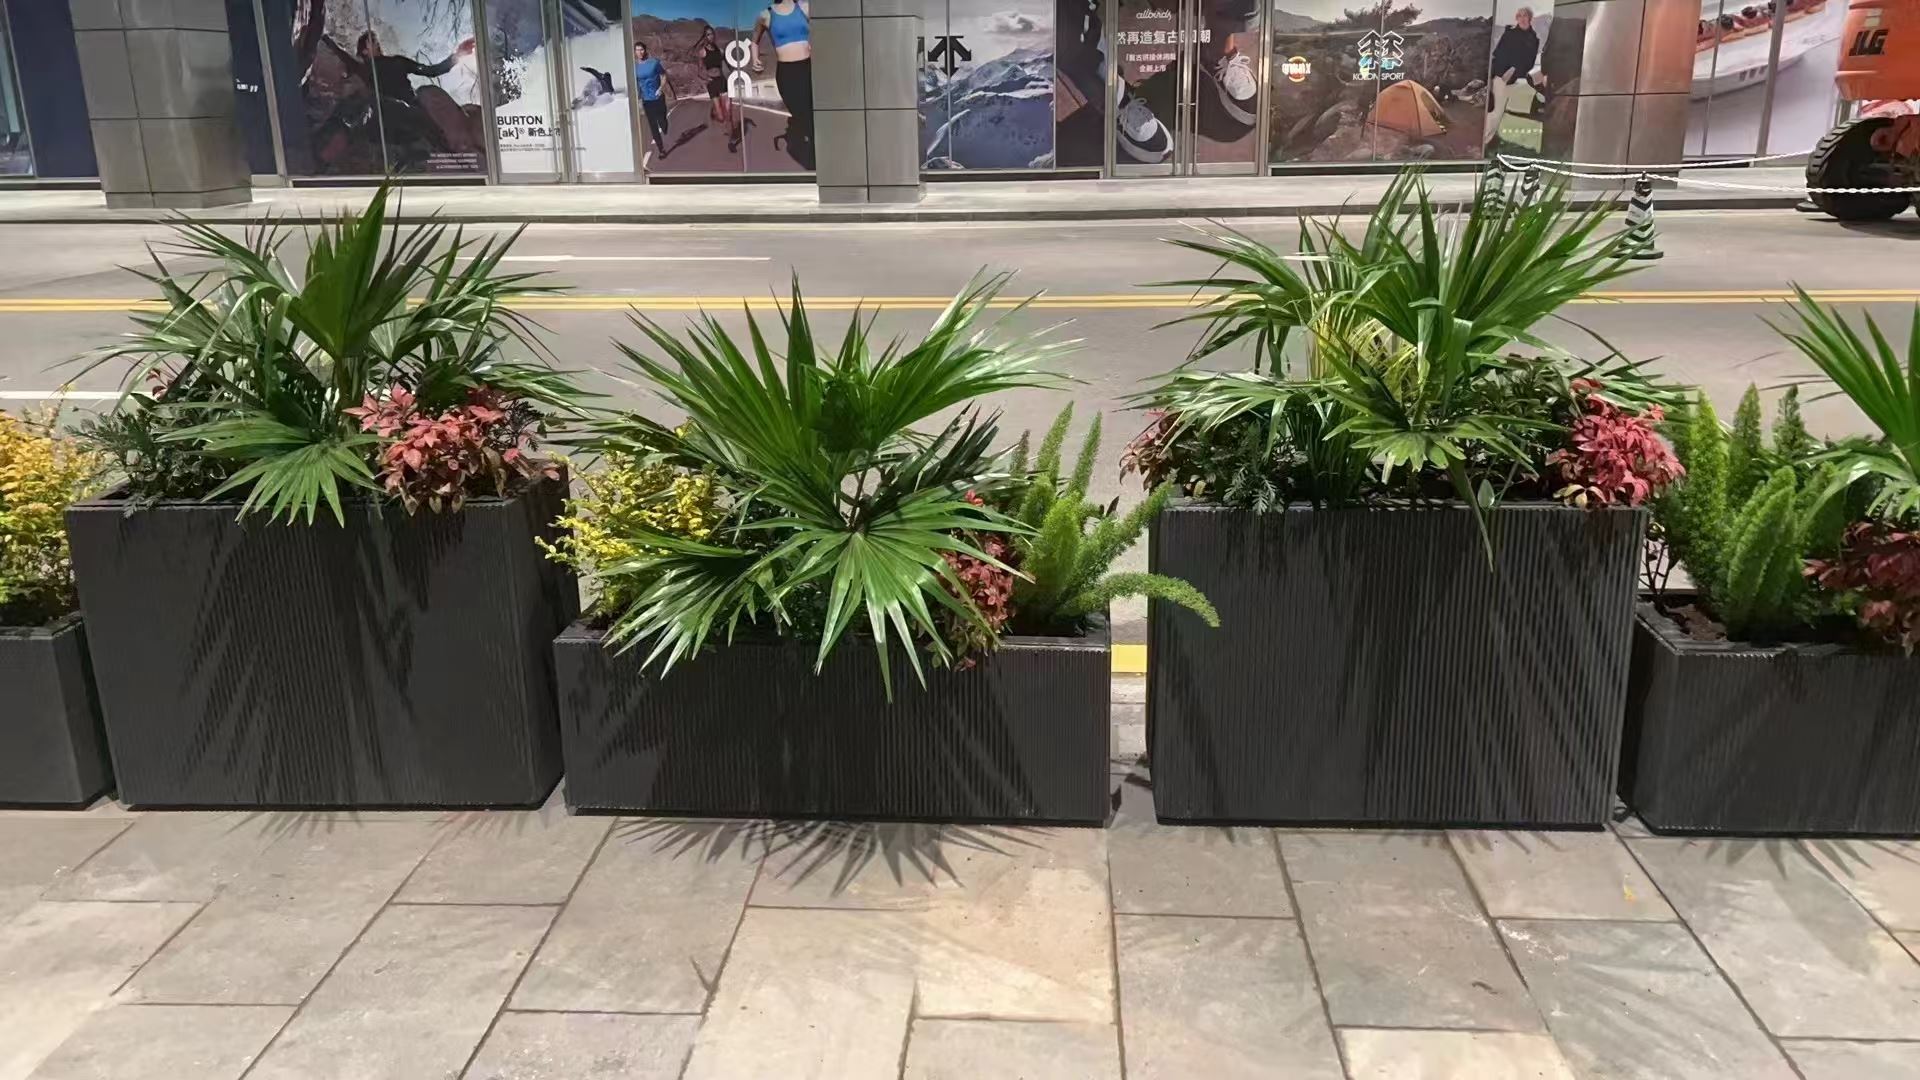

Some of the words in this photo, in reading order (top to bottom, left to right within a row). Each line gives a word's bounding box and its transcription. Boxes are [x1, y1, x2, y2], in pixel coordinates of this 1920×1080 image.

[1136, 8, 1172, 21] allbirds
[1849, 29, 1889, 56] JLG
[1381, 72, 1405, 80] SPORT
[497, 115, 543, 126] BURTON
